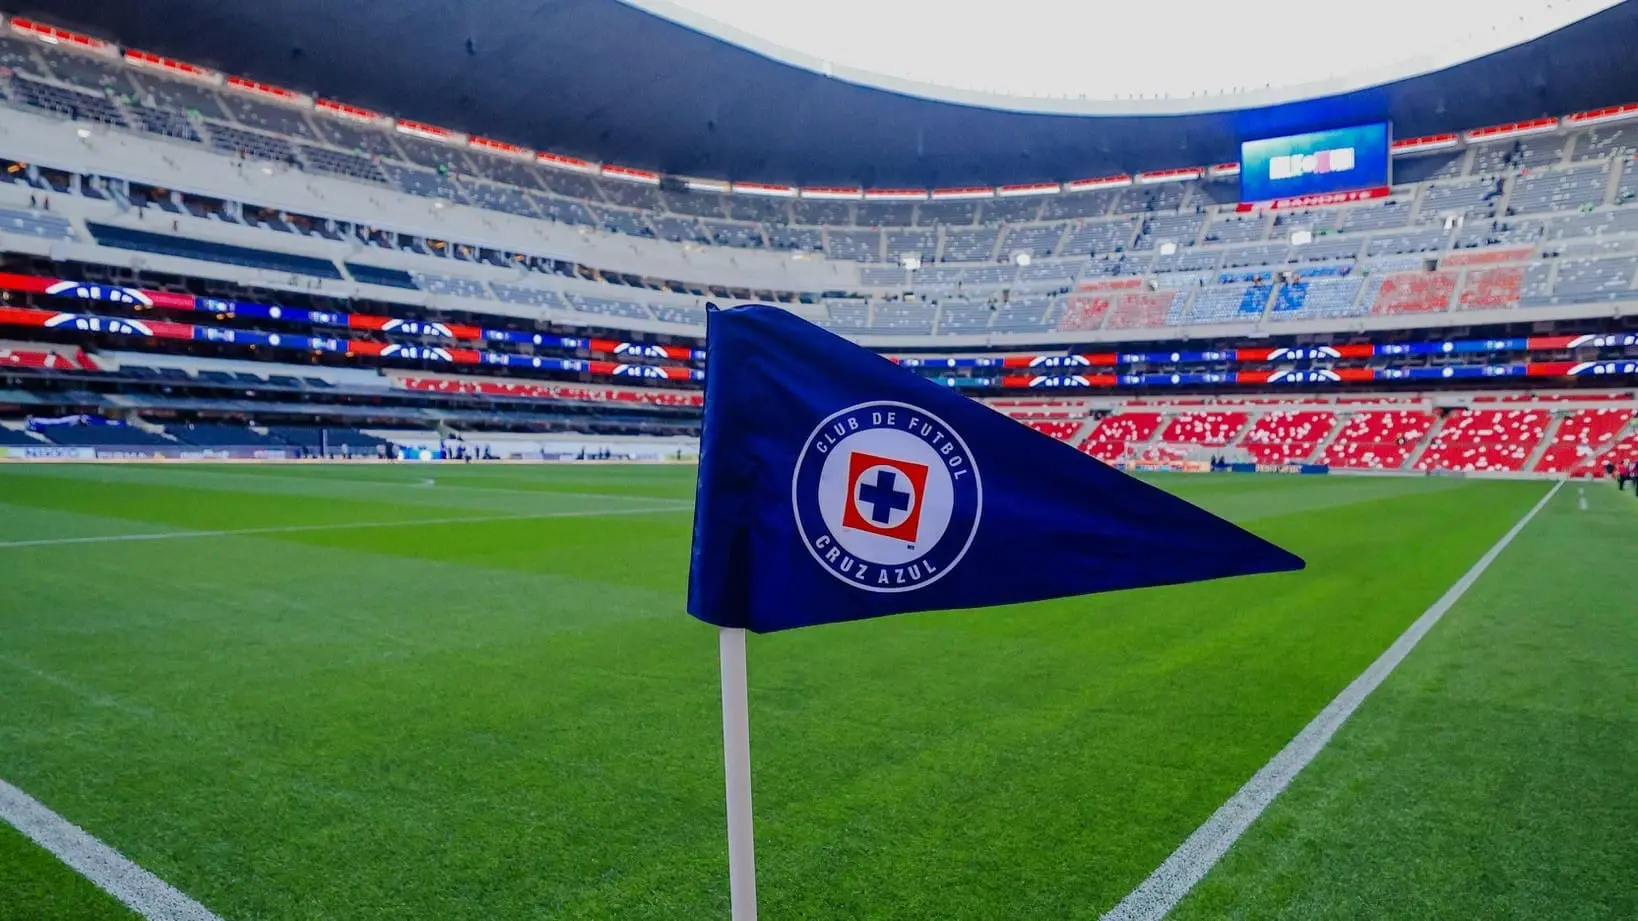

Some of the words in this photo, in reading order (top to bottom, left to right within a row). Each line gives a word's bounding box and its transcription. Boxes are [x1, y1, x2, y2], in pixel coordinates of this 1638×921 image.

[816, 417, 859, 453] CLUB
[872, 412, 896, 425] DE
[908, 417, 968, 480] FUTBOL
[815, 534, 868, 580] CRUZ
[878, 559, 937, 584] AZUL
